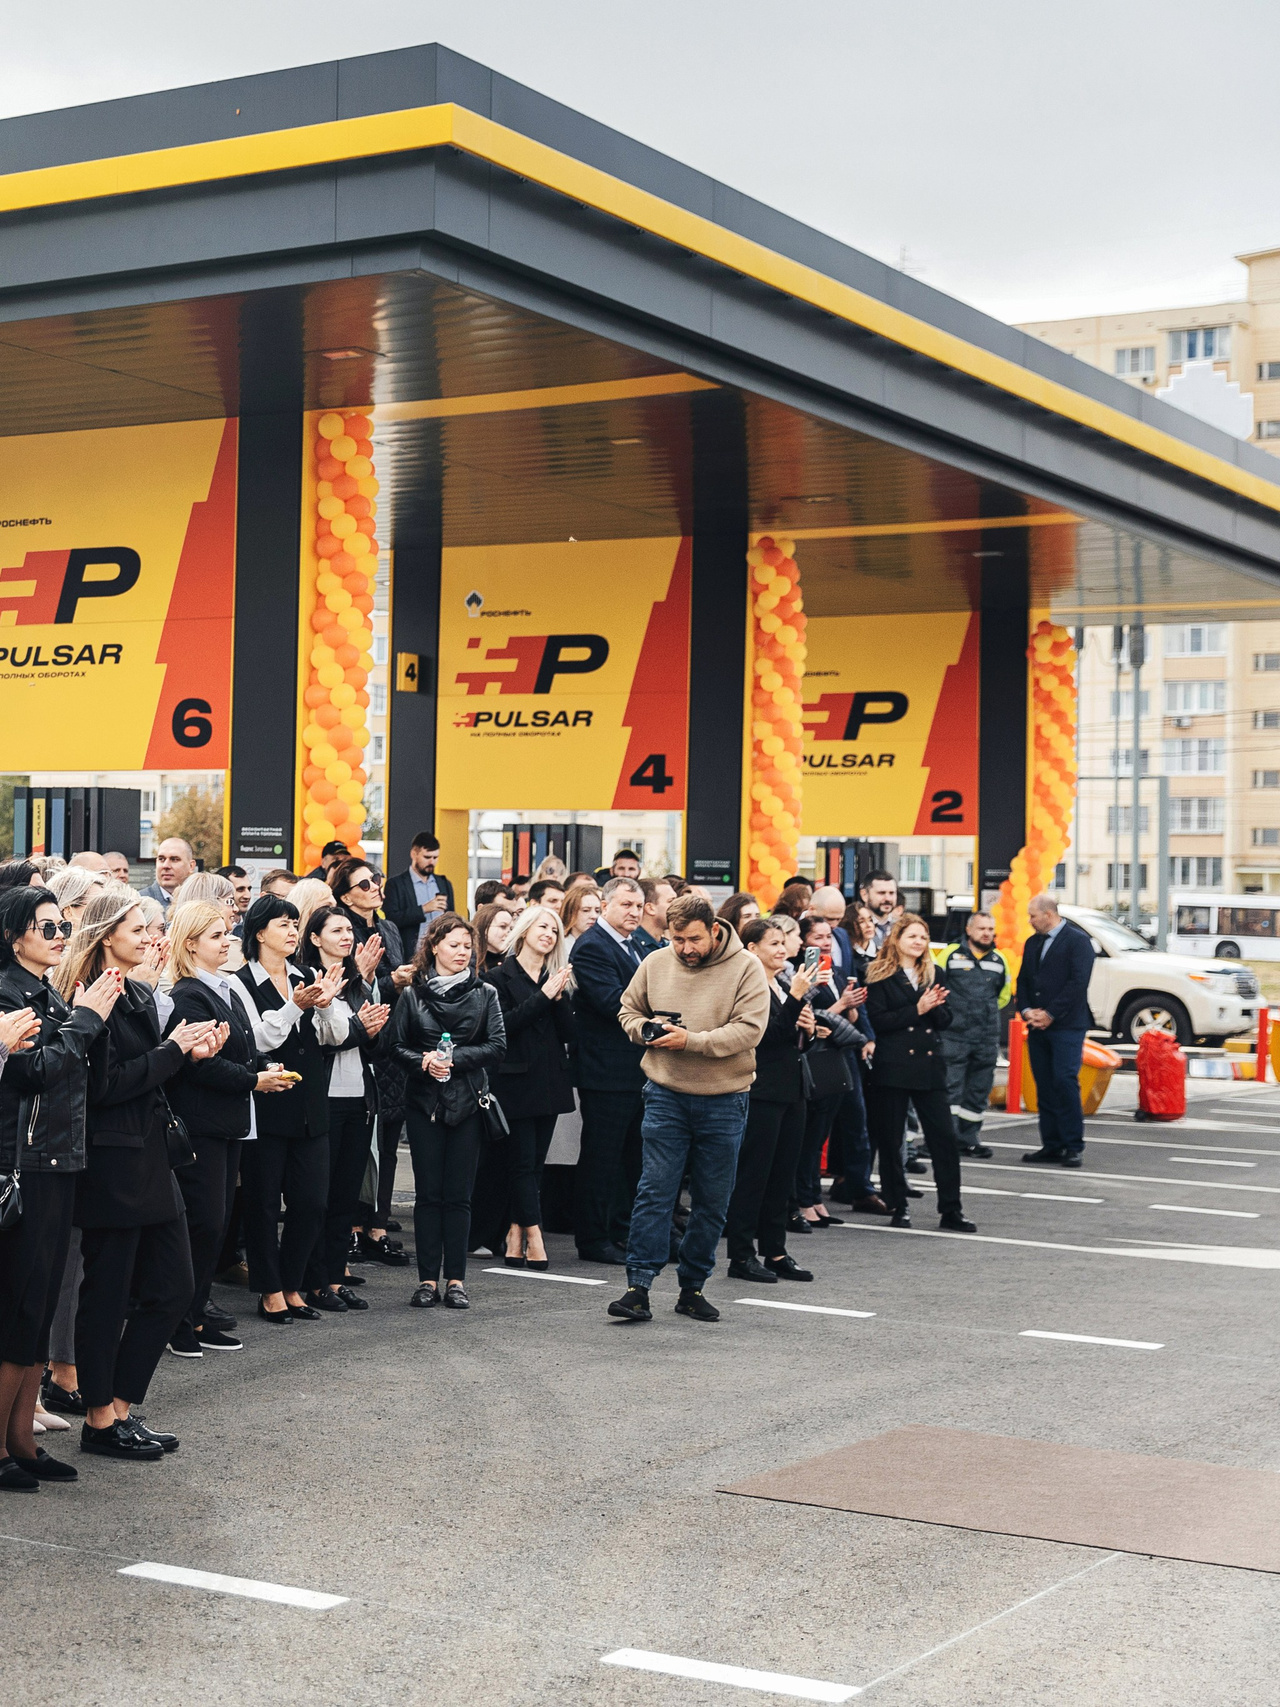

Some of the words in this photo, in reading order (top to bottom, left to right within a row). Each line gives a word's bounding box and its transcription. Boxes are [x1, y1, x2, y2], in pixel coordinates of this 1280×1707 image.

[37, 671, 87, 679] ОБОРОТАХ
[405, 662, 417, 682] 4
[172, 698, 213, 748] 6
[473, 710, 593, 728] PULSAR
[629, 754, 673, 794] 4
[931, 790, 963, 823] 2
